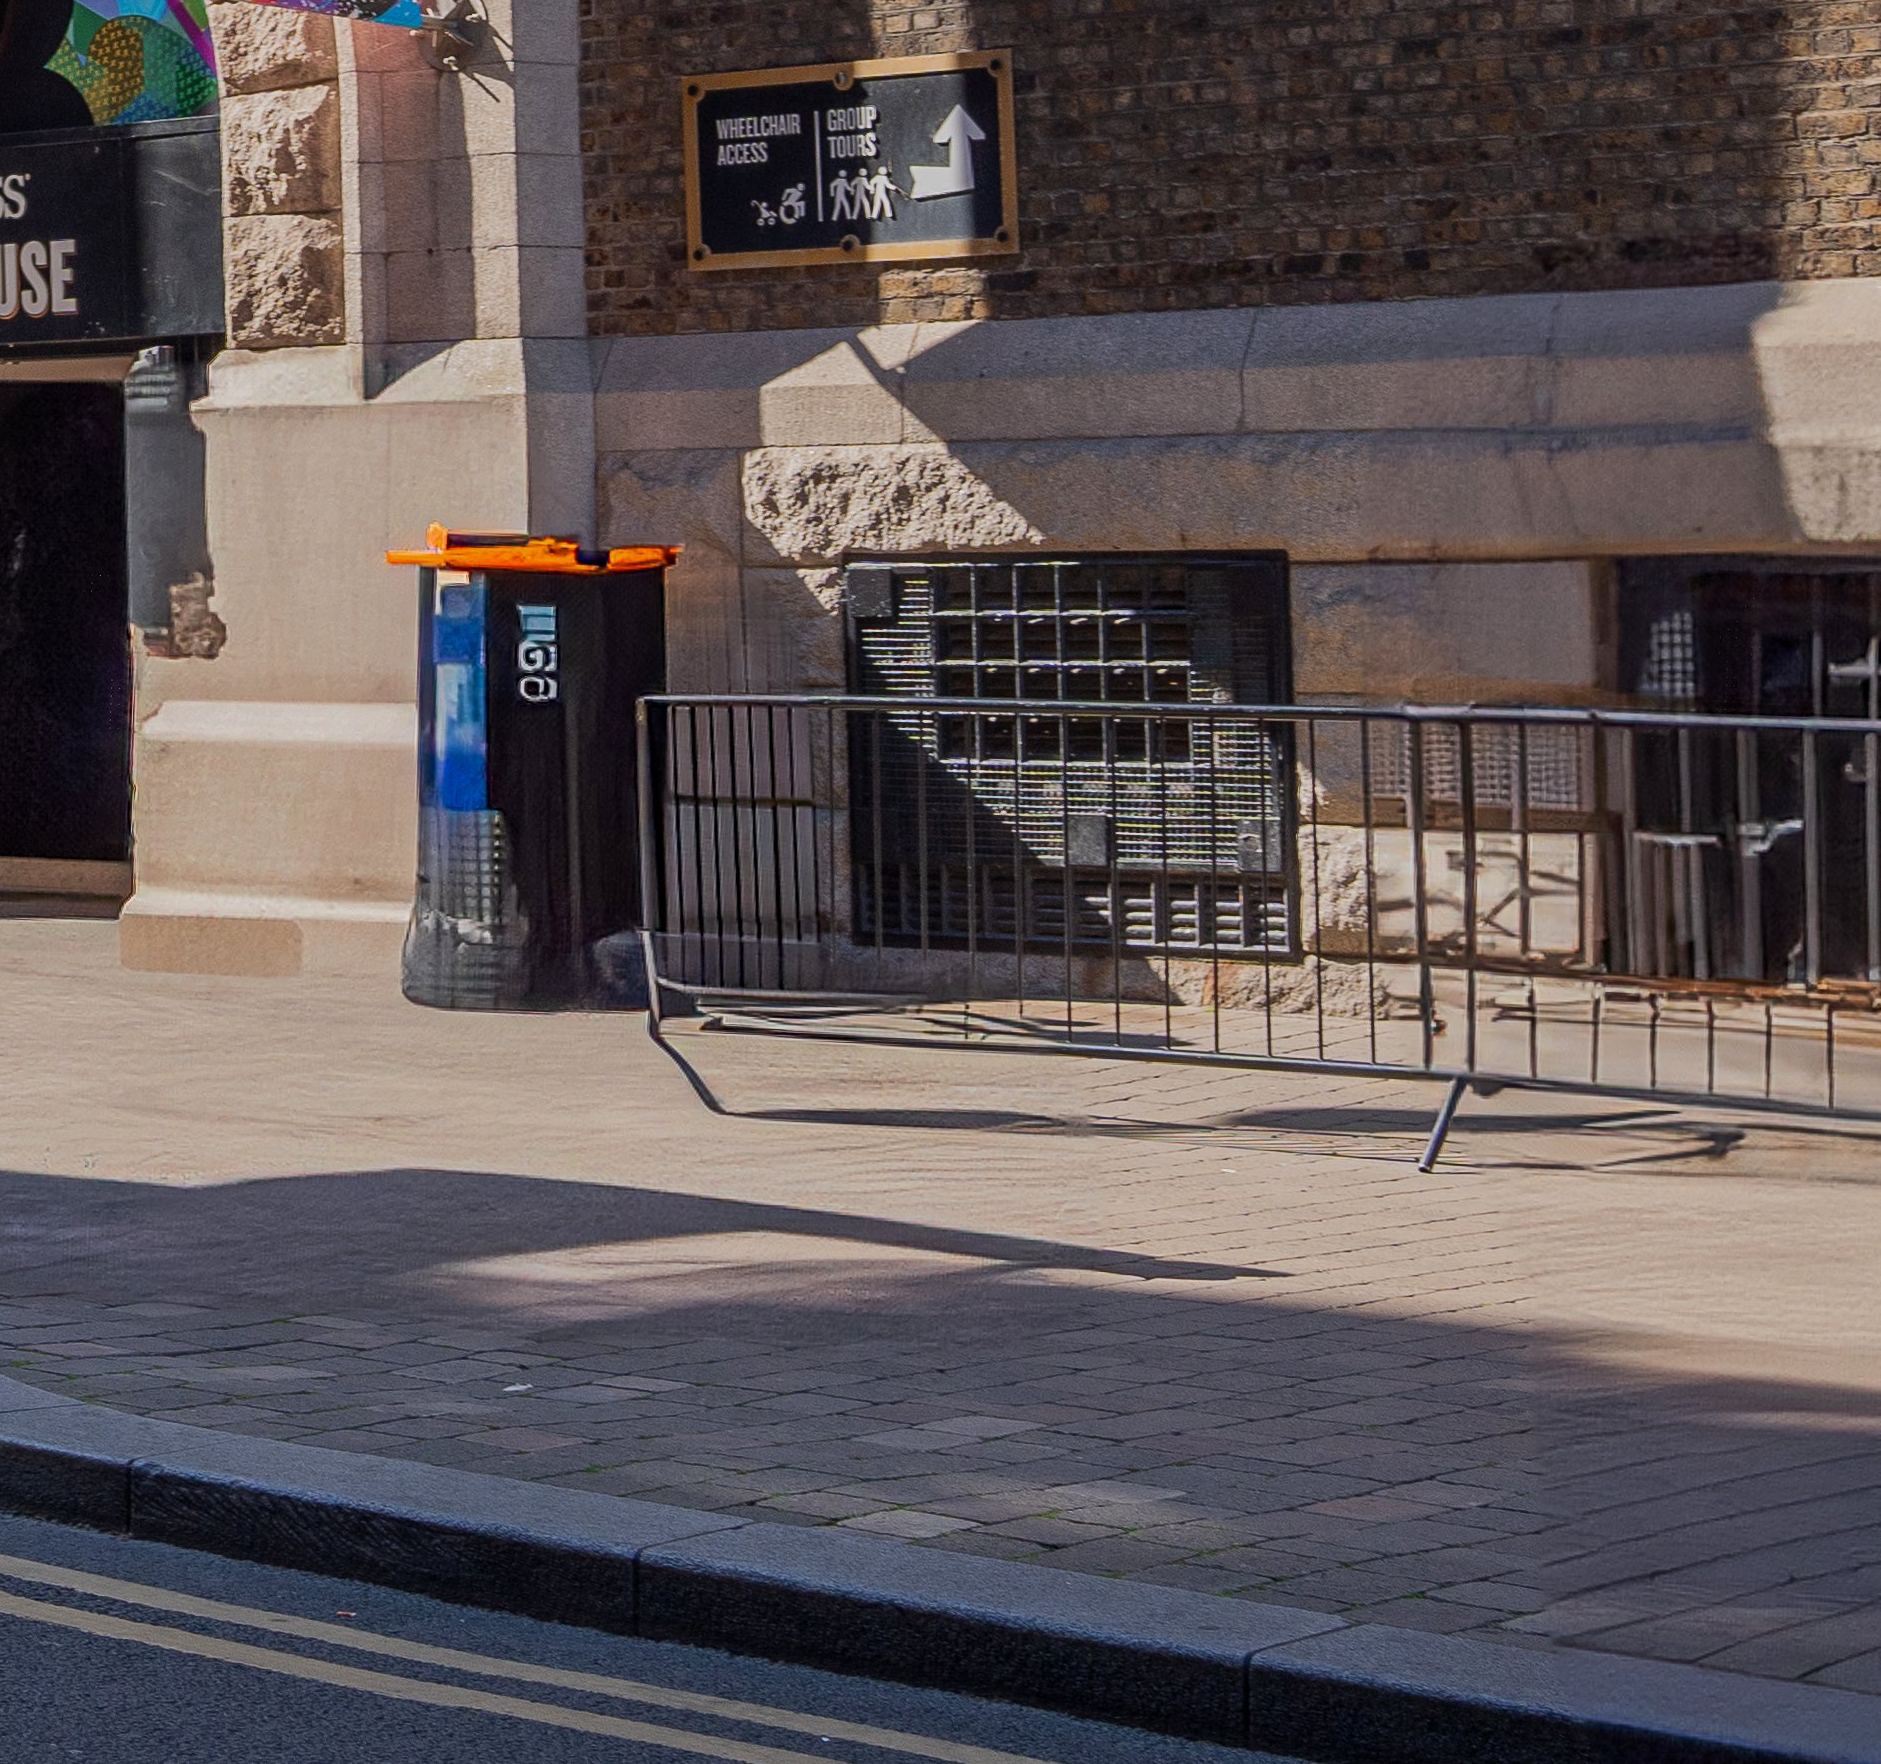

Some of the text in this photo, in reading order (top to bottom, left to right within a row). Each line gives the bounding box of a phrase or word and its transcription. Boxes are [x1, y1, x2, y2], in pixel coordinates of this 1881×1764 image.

[716, 112, 802, 141] WHEELCHAIR
[827, 106, 877, 132] GROUP
[717, 140, 769, 167] ACCESS
[827, 133, 877, 159] TOURS
